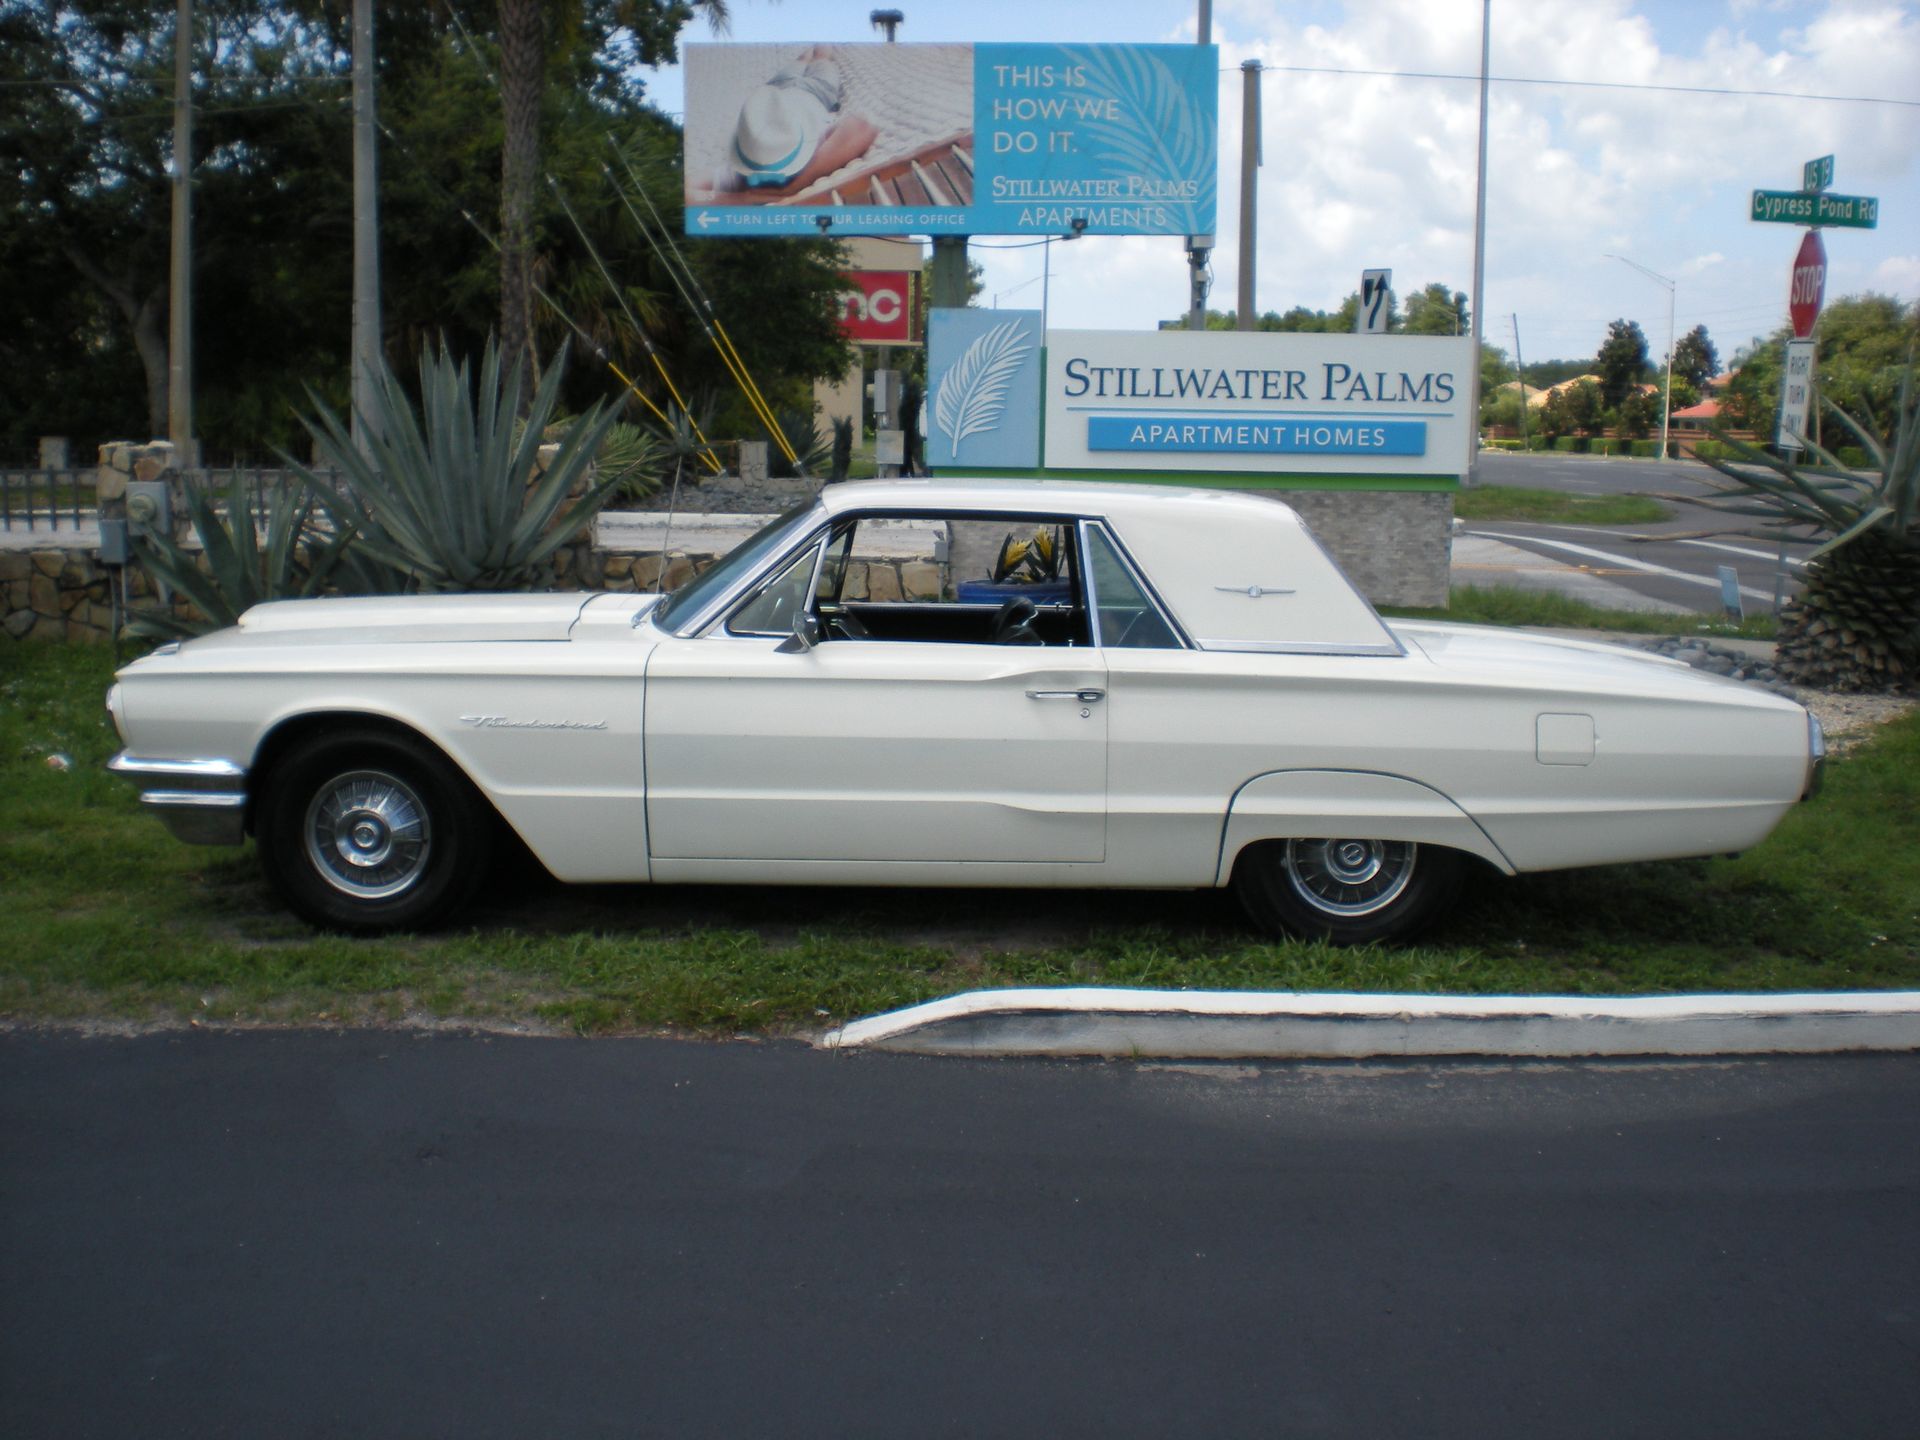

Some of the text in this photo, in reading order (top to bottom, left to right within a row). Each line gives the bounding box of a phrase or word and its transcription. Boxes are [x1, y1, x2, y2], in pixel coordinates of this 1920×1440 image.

[993, 65, 1087, 87] THIS IS
[993, 98, 1120, 121] HOW WE
[993, 131, 1078, 153] DO IT.
[991, 174, 1199, 198] STILLWATER PALMS
[1018, 206, 1168, 227] APARTMENTS
[1754, 191, 1877, 220] Cypress Pond Rd
[725, 213, 762, 226] TURN
[766, 213, 797, 225] LEFT
[858, 213, 914, 225] LEASING
[919, 213, 966, 225] OFFICE
[1792, 264, 1825, 305] STOP
[1063, 357, 1456, 404] STILLWATER PALMS
[1130, 423, 1386, 447] APARTMENT HOMES
